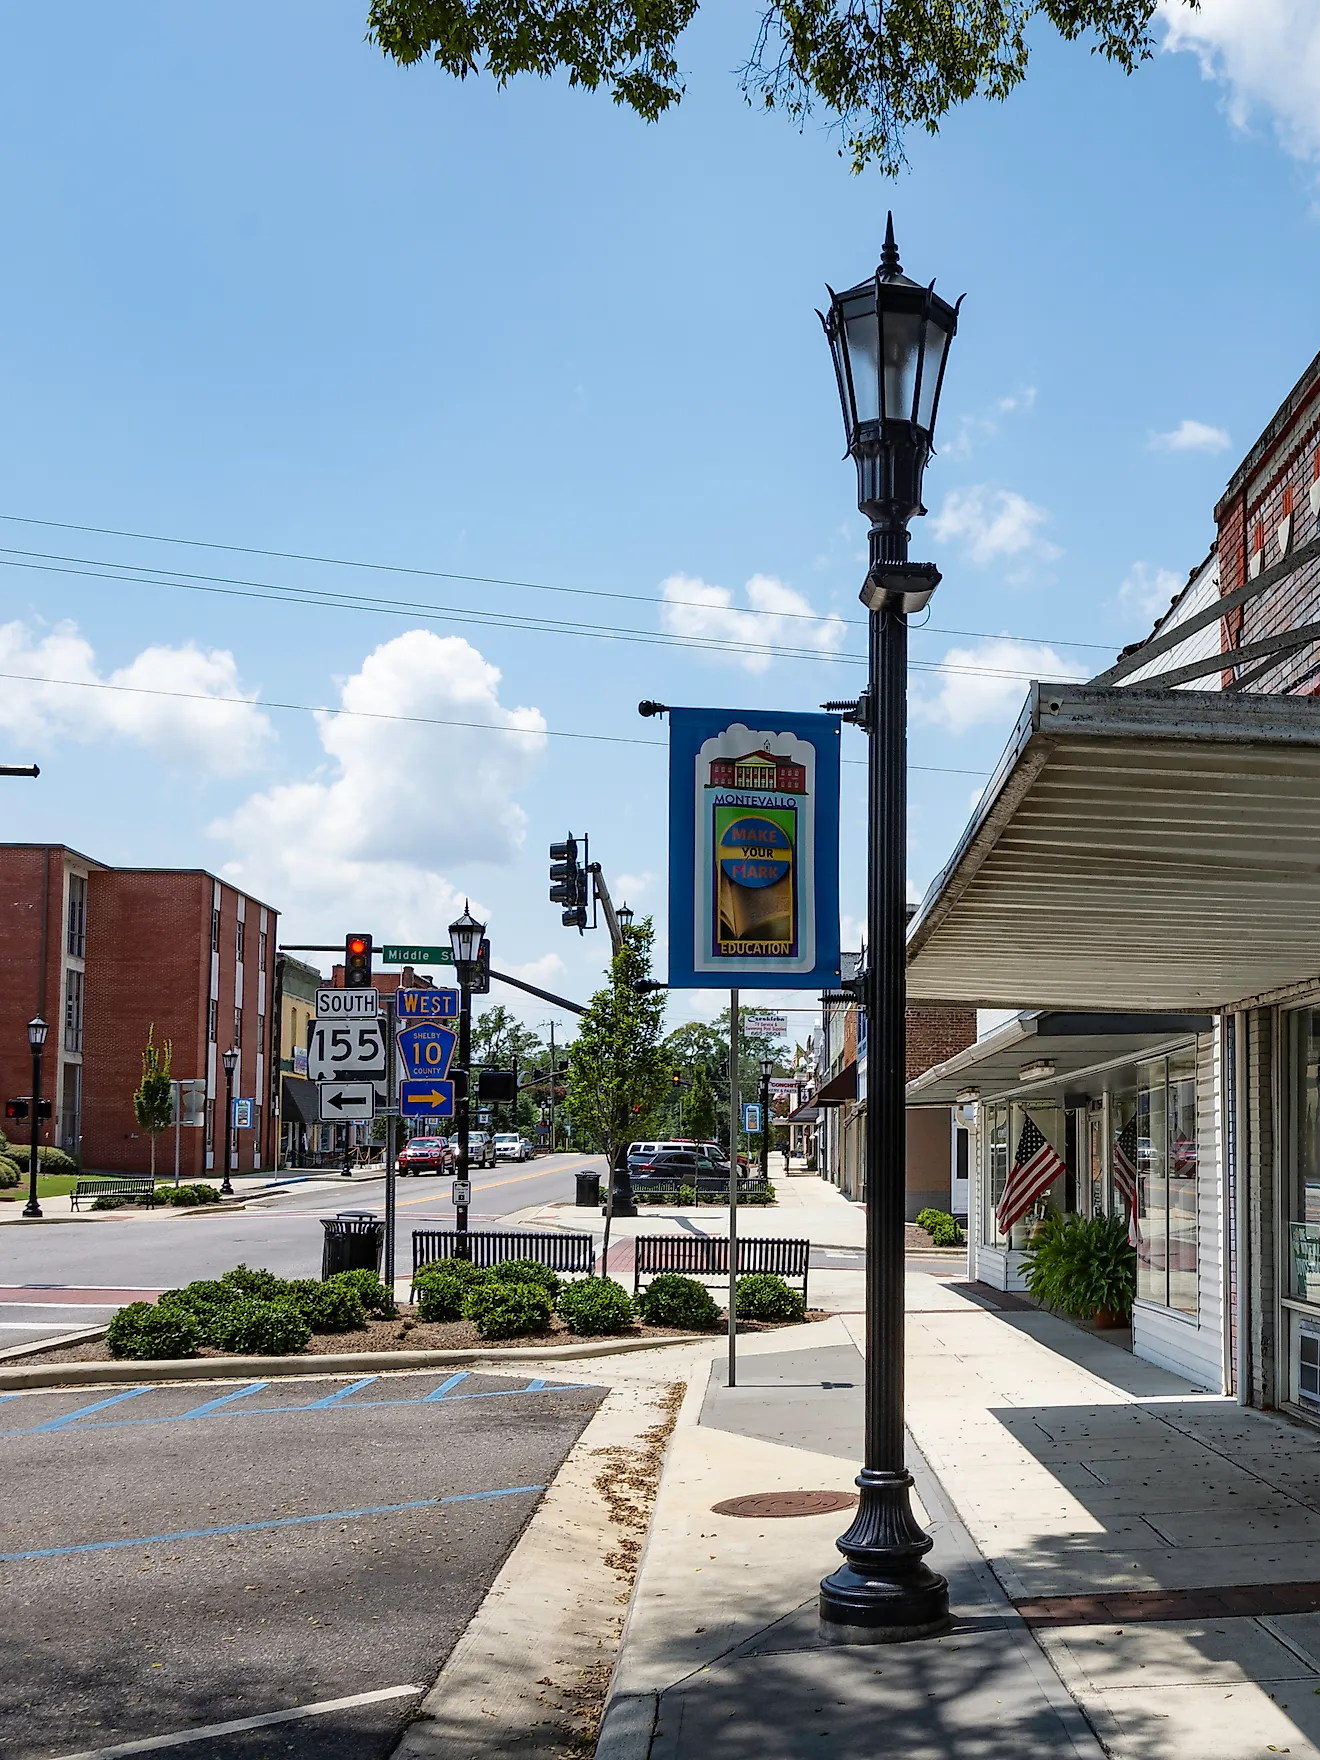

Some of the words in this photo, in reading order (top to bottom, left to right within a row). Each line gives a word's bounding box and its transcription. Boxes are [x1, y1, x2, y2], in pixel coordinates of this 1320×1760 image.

[713, 794, 797, 808] MONTEVALLO
[732, 828, 777, 843] MAKE
[742, 847, 774, 858] YOUR
[732, 865, 779, 879] MARK
[388, 950, 430, 961] Middle
[720, 942, 790, 955] EDUCATION
[319, 994, 375, 1012] SOUTH
[403, 993, 452, 1013] WEST
[315, 1029, 379, 1062] 155
[413, 1042, 442, 1065] 10
[413, 1067, 442, 1075] COUNTY
